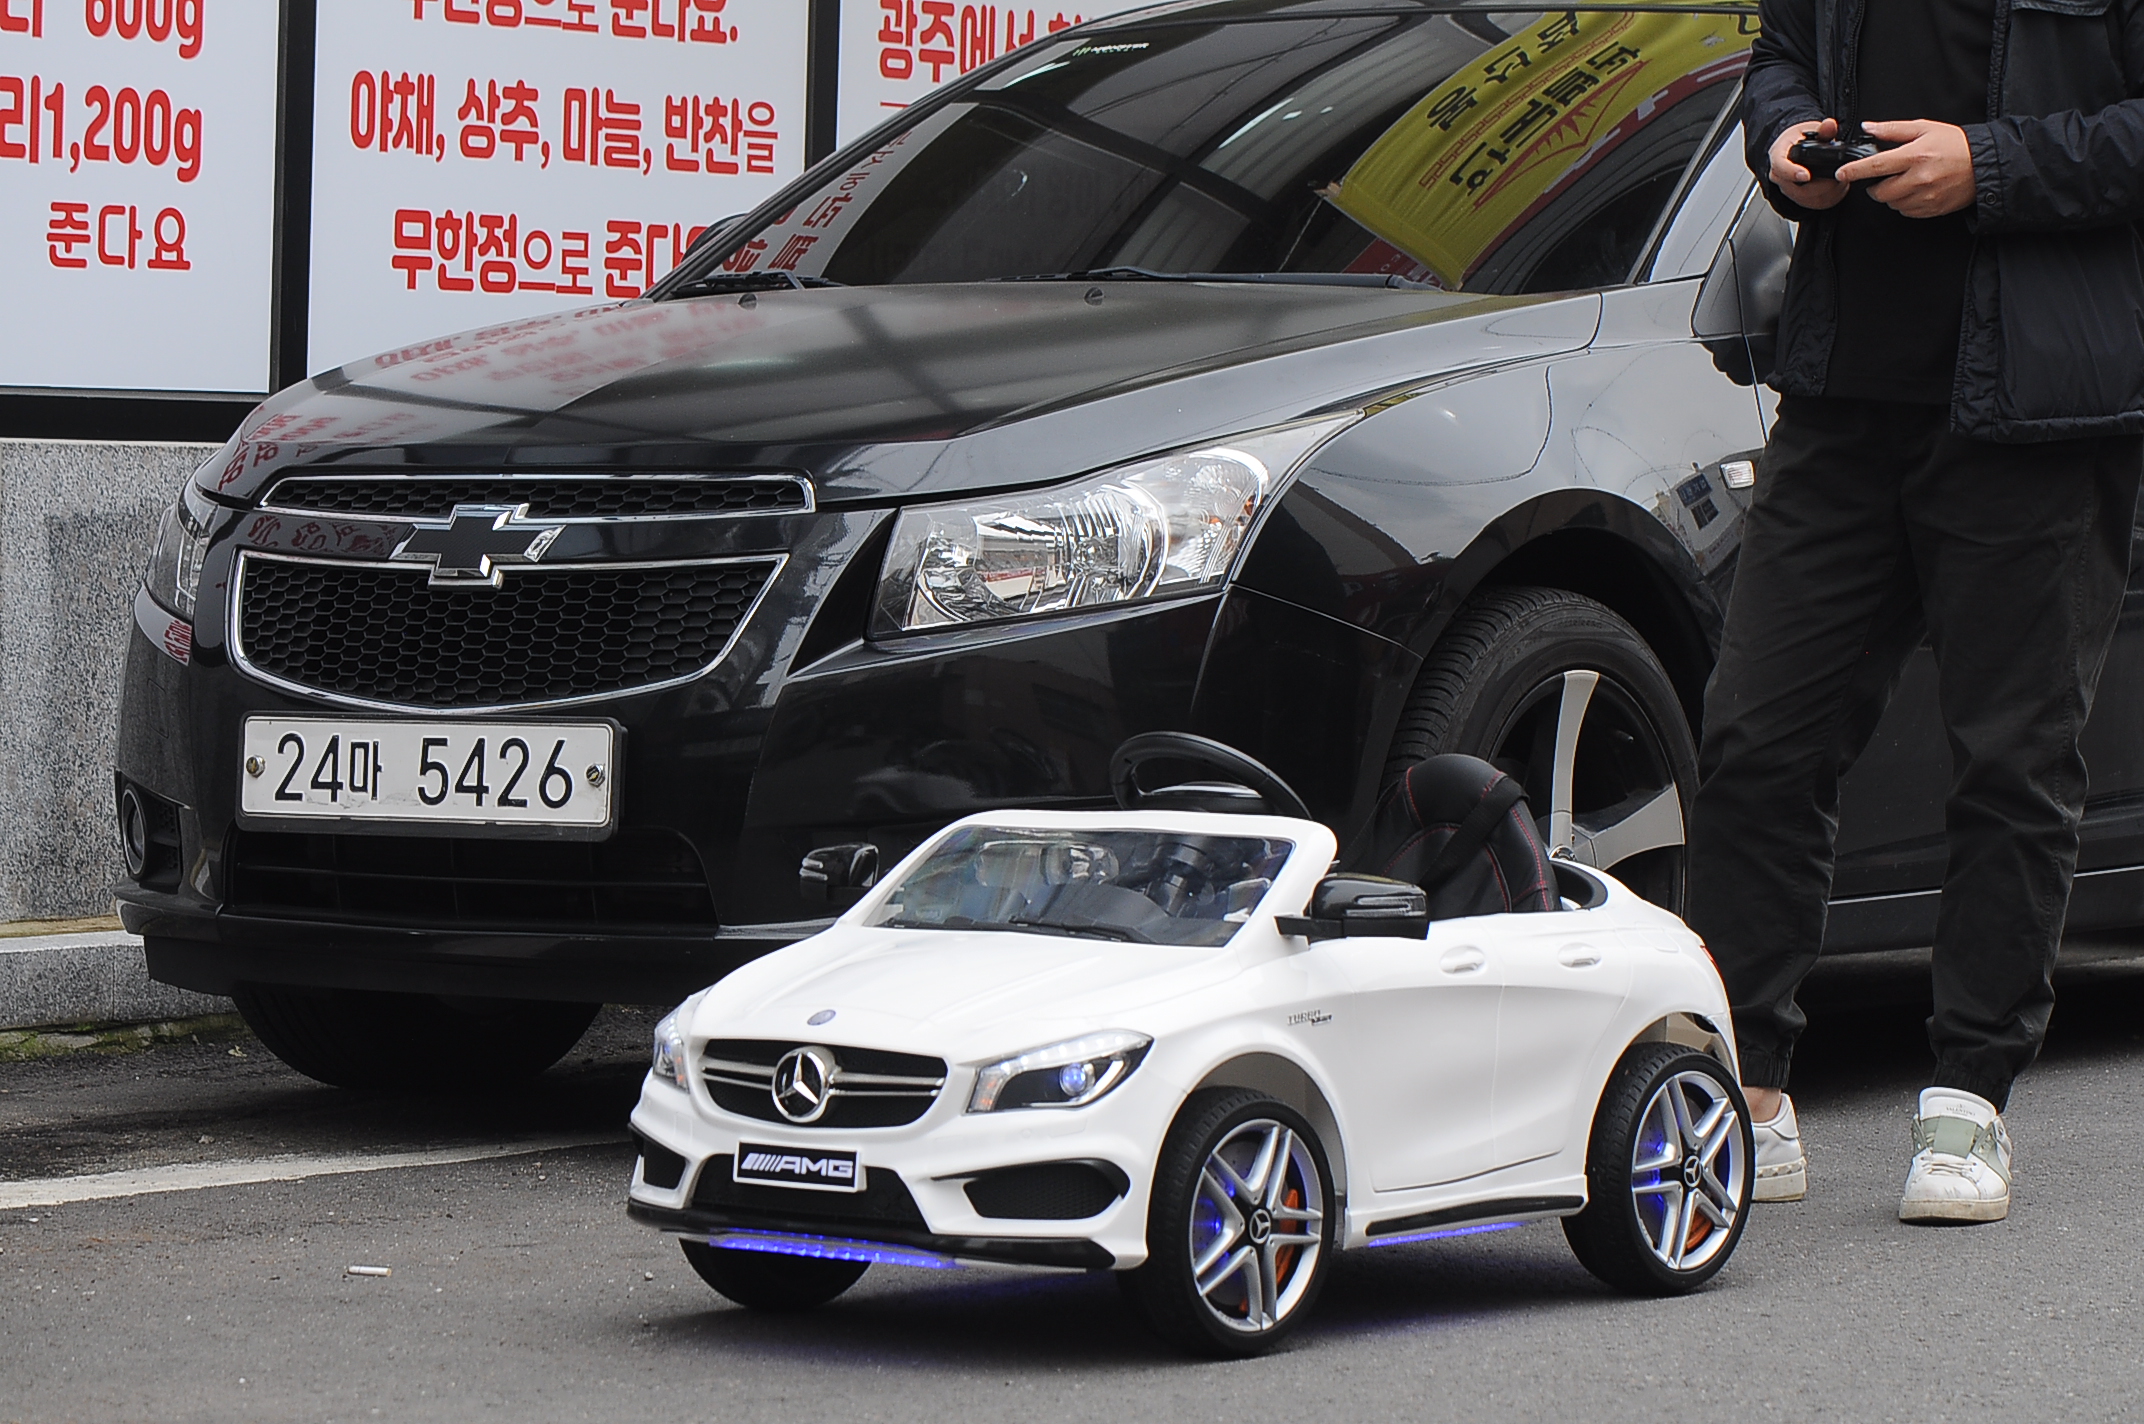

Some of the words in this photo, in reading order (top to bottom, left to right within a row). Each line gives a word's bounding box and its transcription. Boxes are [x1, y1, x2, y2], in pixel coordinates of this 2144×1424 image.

[350, 70, 445, 162] 야채,
[458, 78, 550, 170] 상추,
[562, 86, 652, 176] 마늘,
[664, 94, 778, 175] 반찬을
[46, 201, 191, 270] 준다요
[391, 208, 594, 296] 무한정으로
[604, 219, 709, 299] 준다
[274, 732, 383, 803] 24마
[417, 737, 575, 809] 5426
[776, 1154, 854, 1179] AMG
